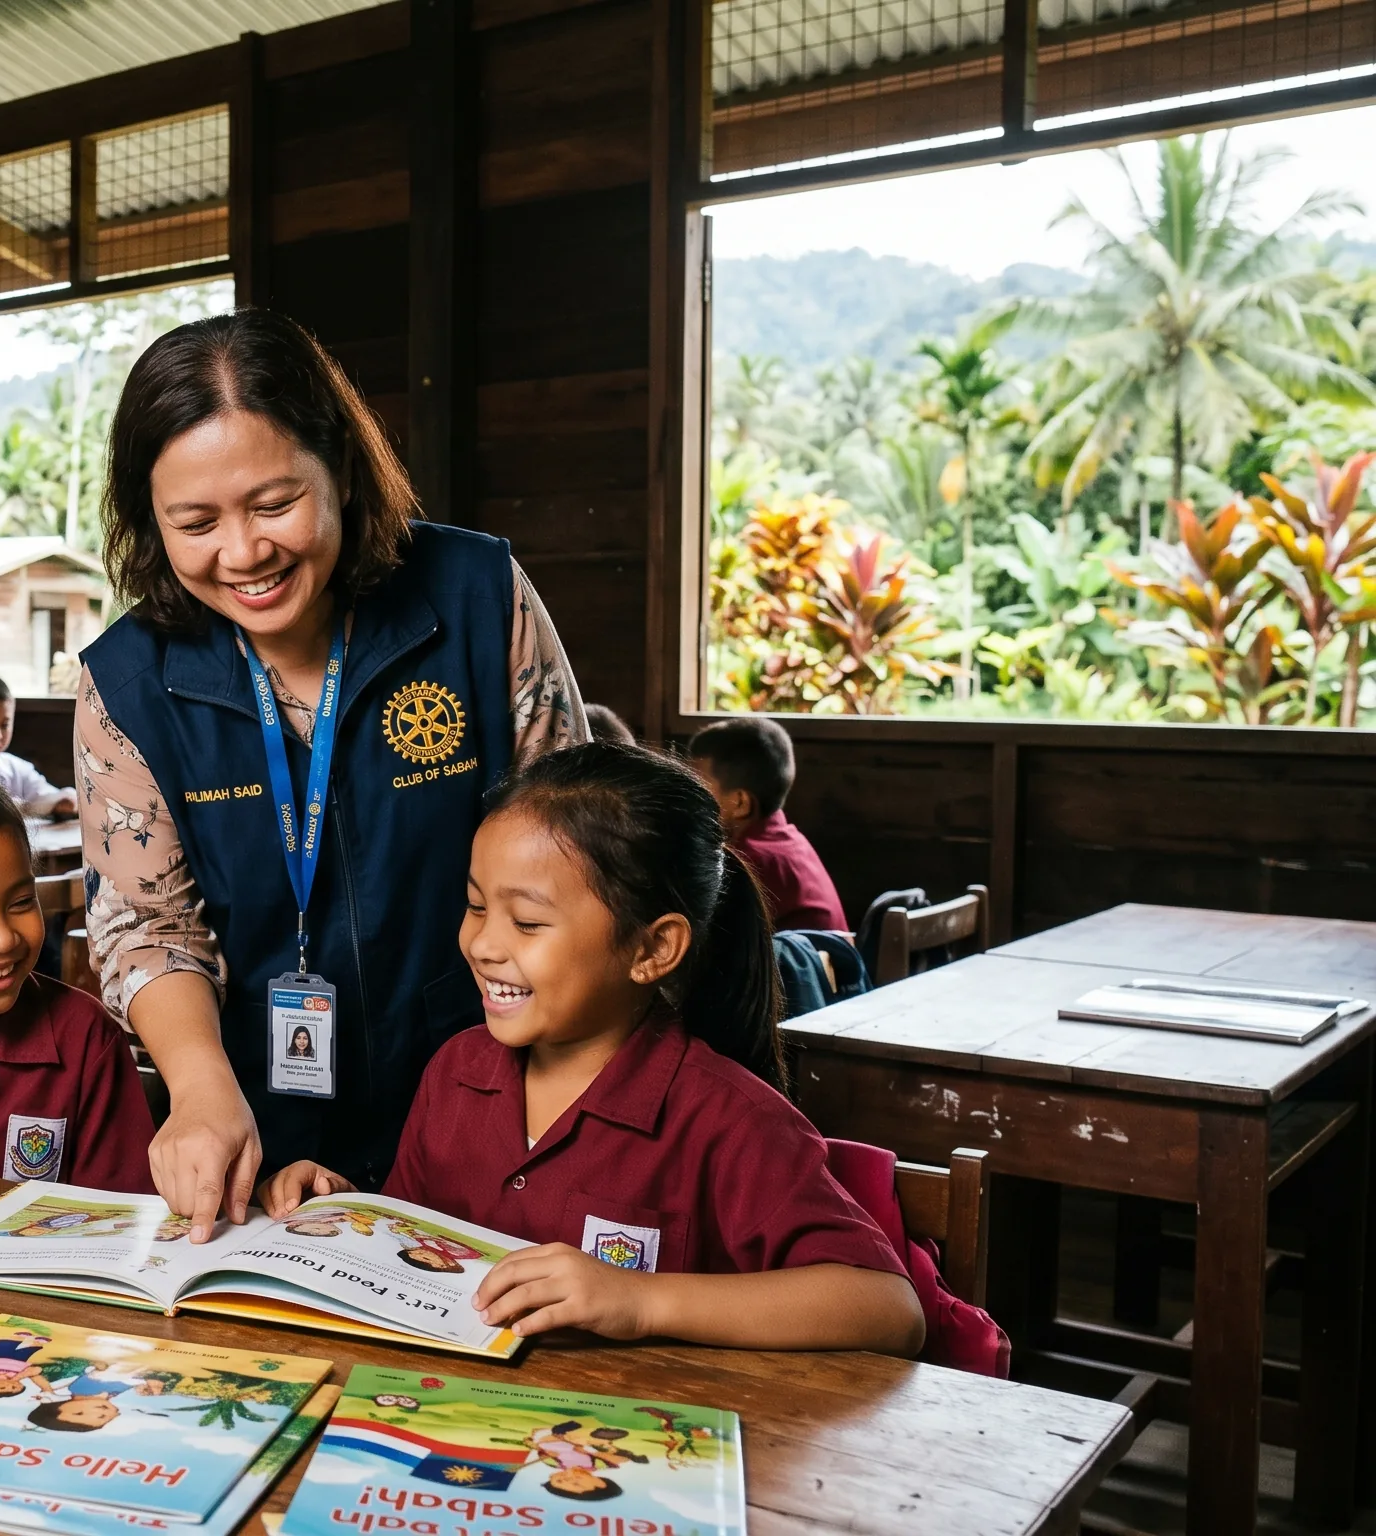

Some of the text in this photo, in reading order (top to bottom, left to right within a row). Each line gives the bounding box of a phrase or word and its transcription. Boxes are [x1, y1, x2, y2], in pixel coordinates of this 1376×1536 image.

[392, 757, 478, 789] CLUB OF SABAH
[233, 783, 263, 798] SAID
[395, 1292, 450, 1319] Let's
[63, 1454, 190, 1487] Hello
[358, 1485, 674, 1536] ello Sabah!
